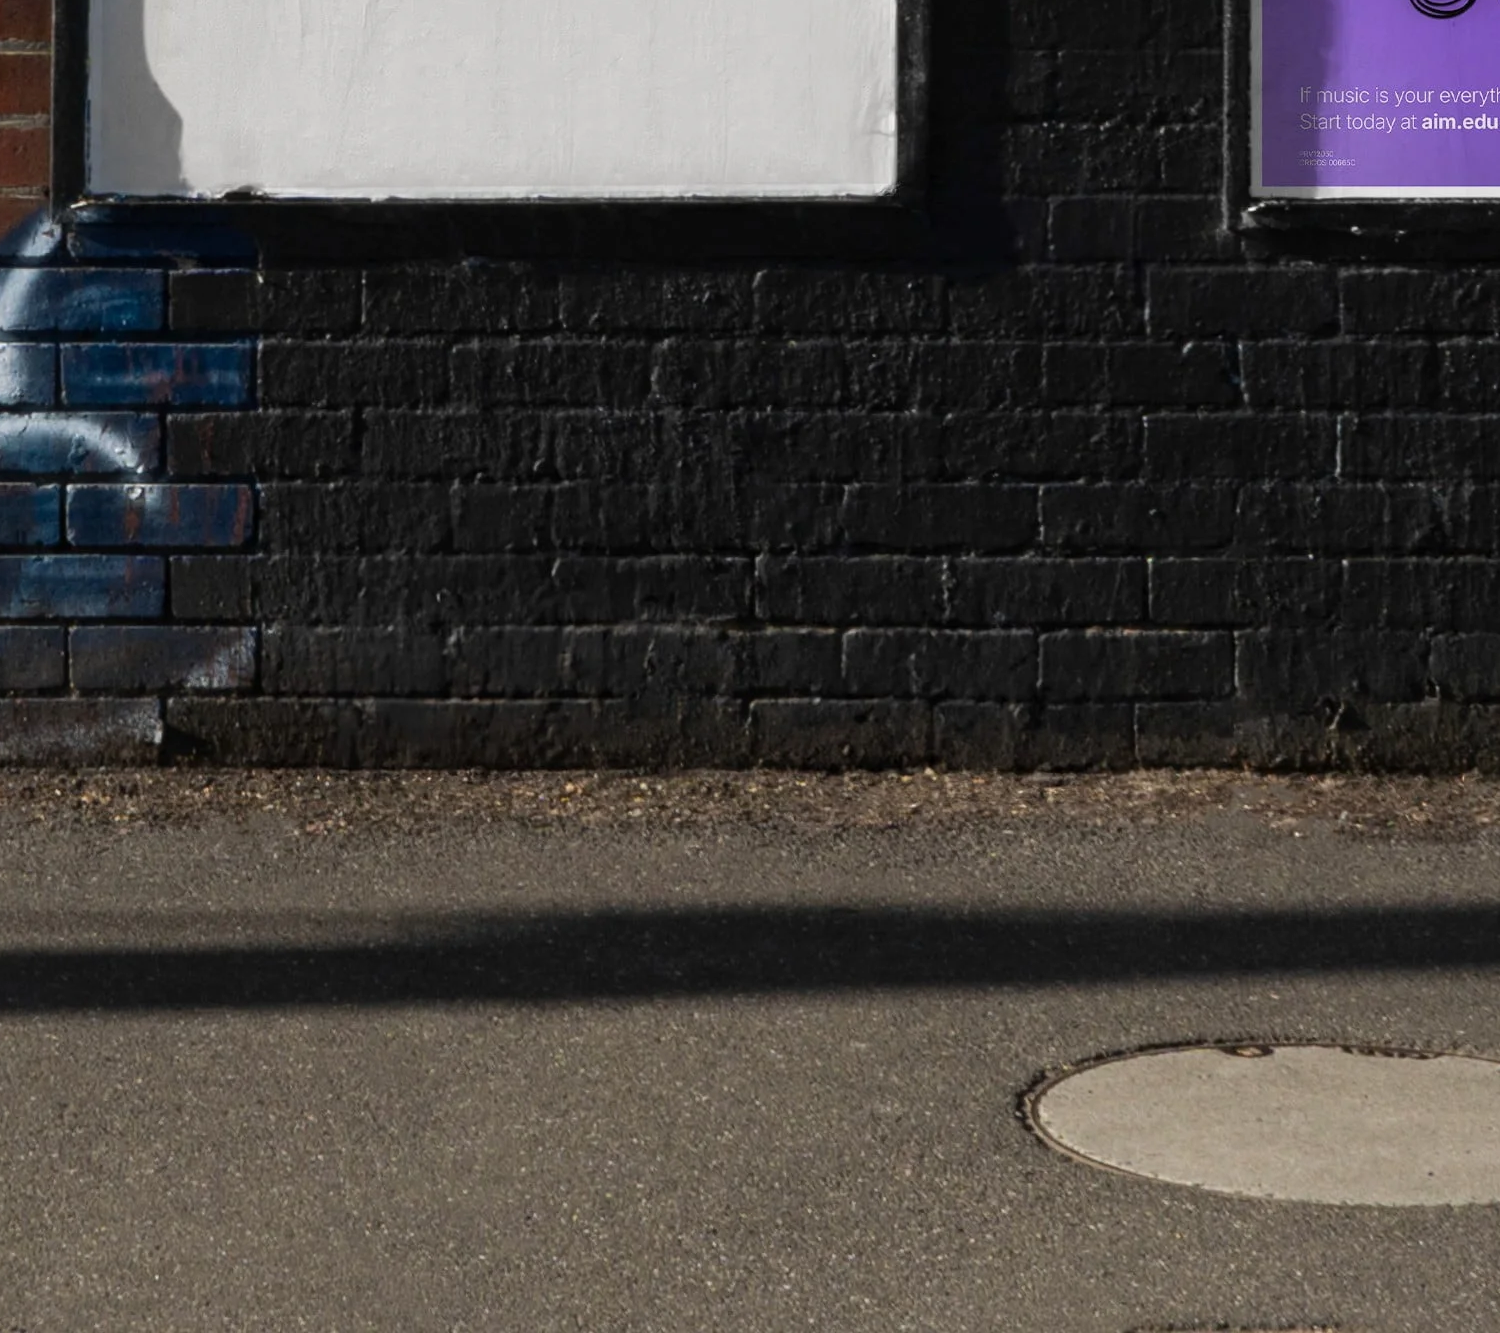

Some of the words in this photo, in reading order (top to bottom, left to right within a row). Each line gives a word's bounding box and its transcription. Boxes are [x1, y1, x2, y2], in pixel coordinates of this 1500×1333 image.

[1299, 86, 1312, 103] If
[1316, 87, 1370, 103] music
[1375, 87, 1389, 103] is
[1394, 90, 1435, 107] your
[1299, 113, 1341, 130] Start
[1346, 113, 1396, 134] today
[1400, 115, 1418, 130] at
